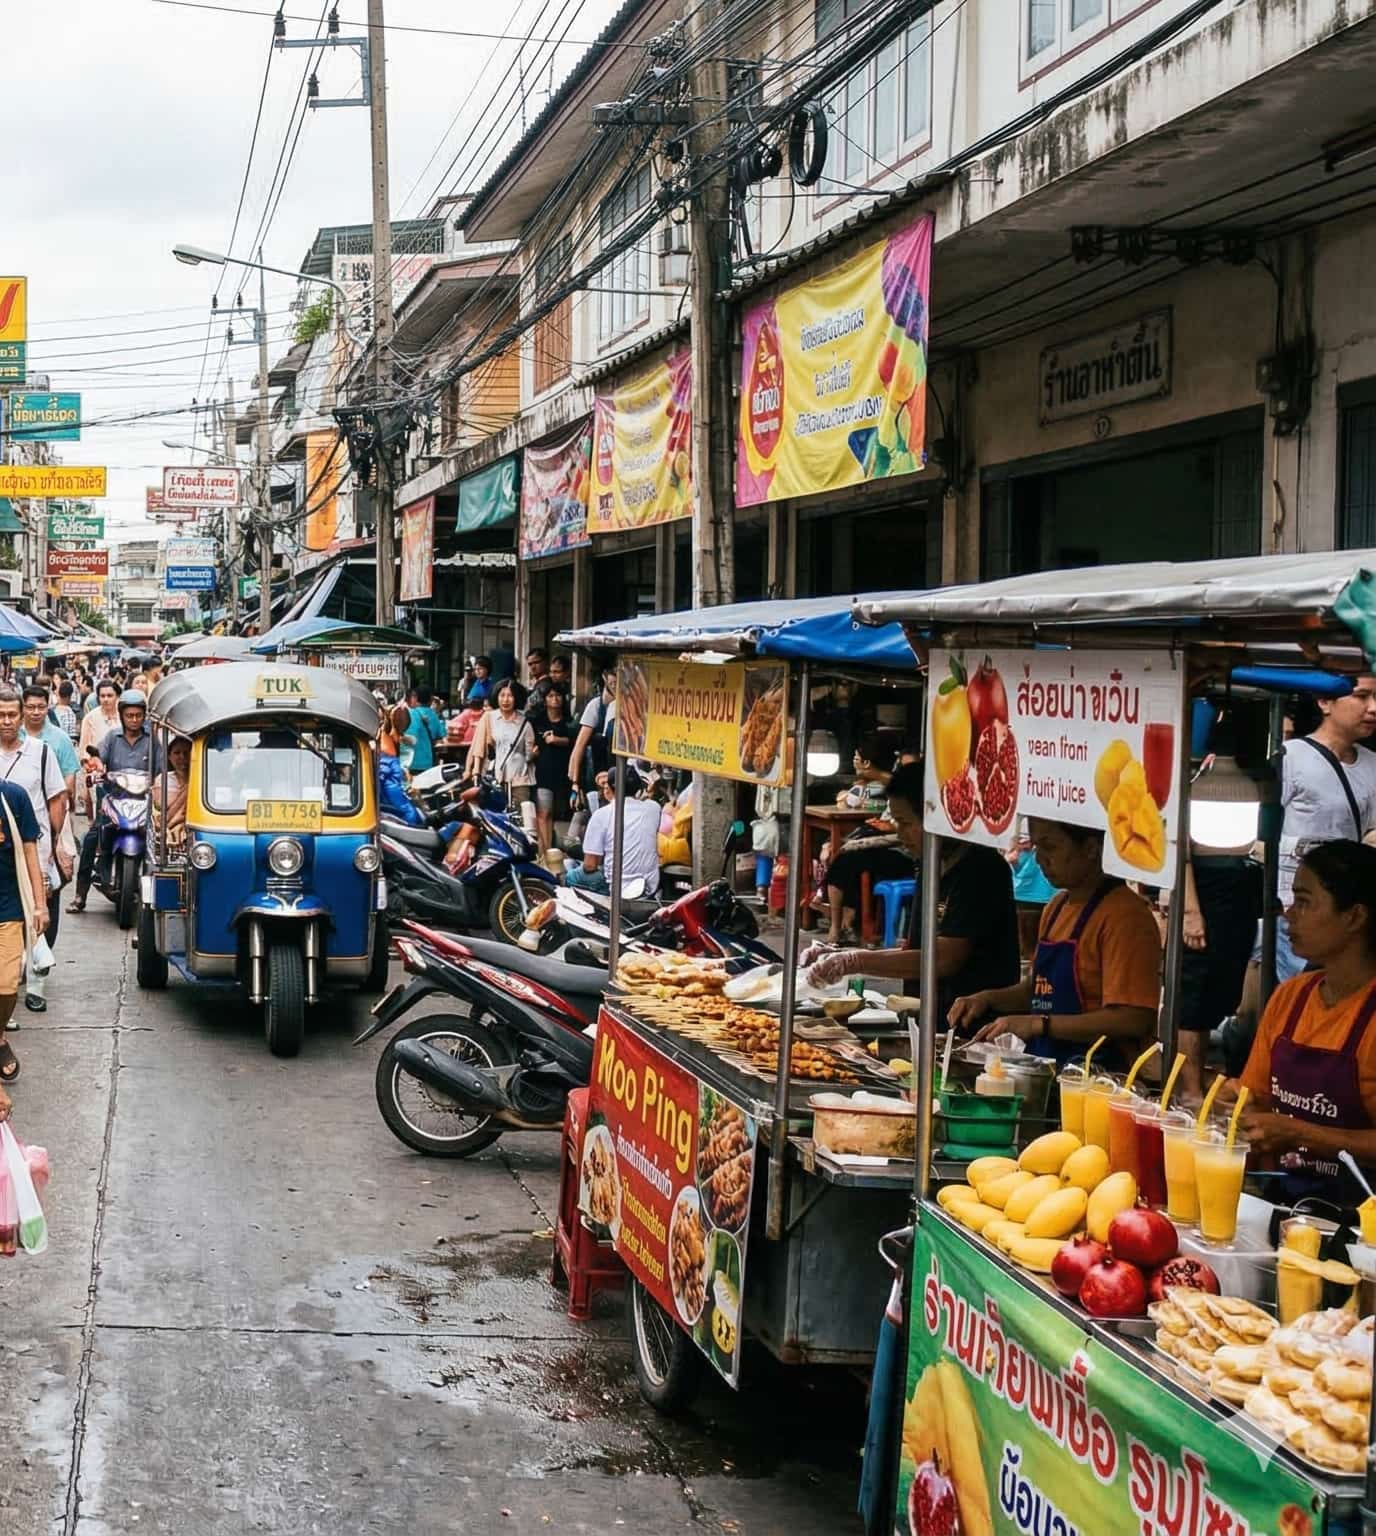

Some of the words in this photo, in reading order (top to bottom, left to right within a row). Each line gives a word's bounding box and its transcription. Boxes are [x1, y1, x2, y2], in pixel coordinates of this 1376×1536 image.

[263, 678, 303, 693] TUK
[1057, 778, 1086, 807] juice
[598, 1032, 637, 1112] Moo
[642, 1065, 693, 1174] Ping
